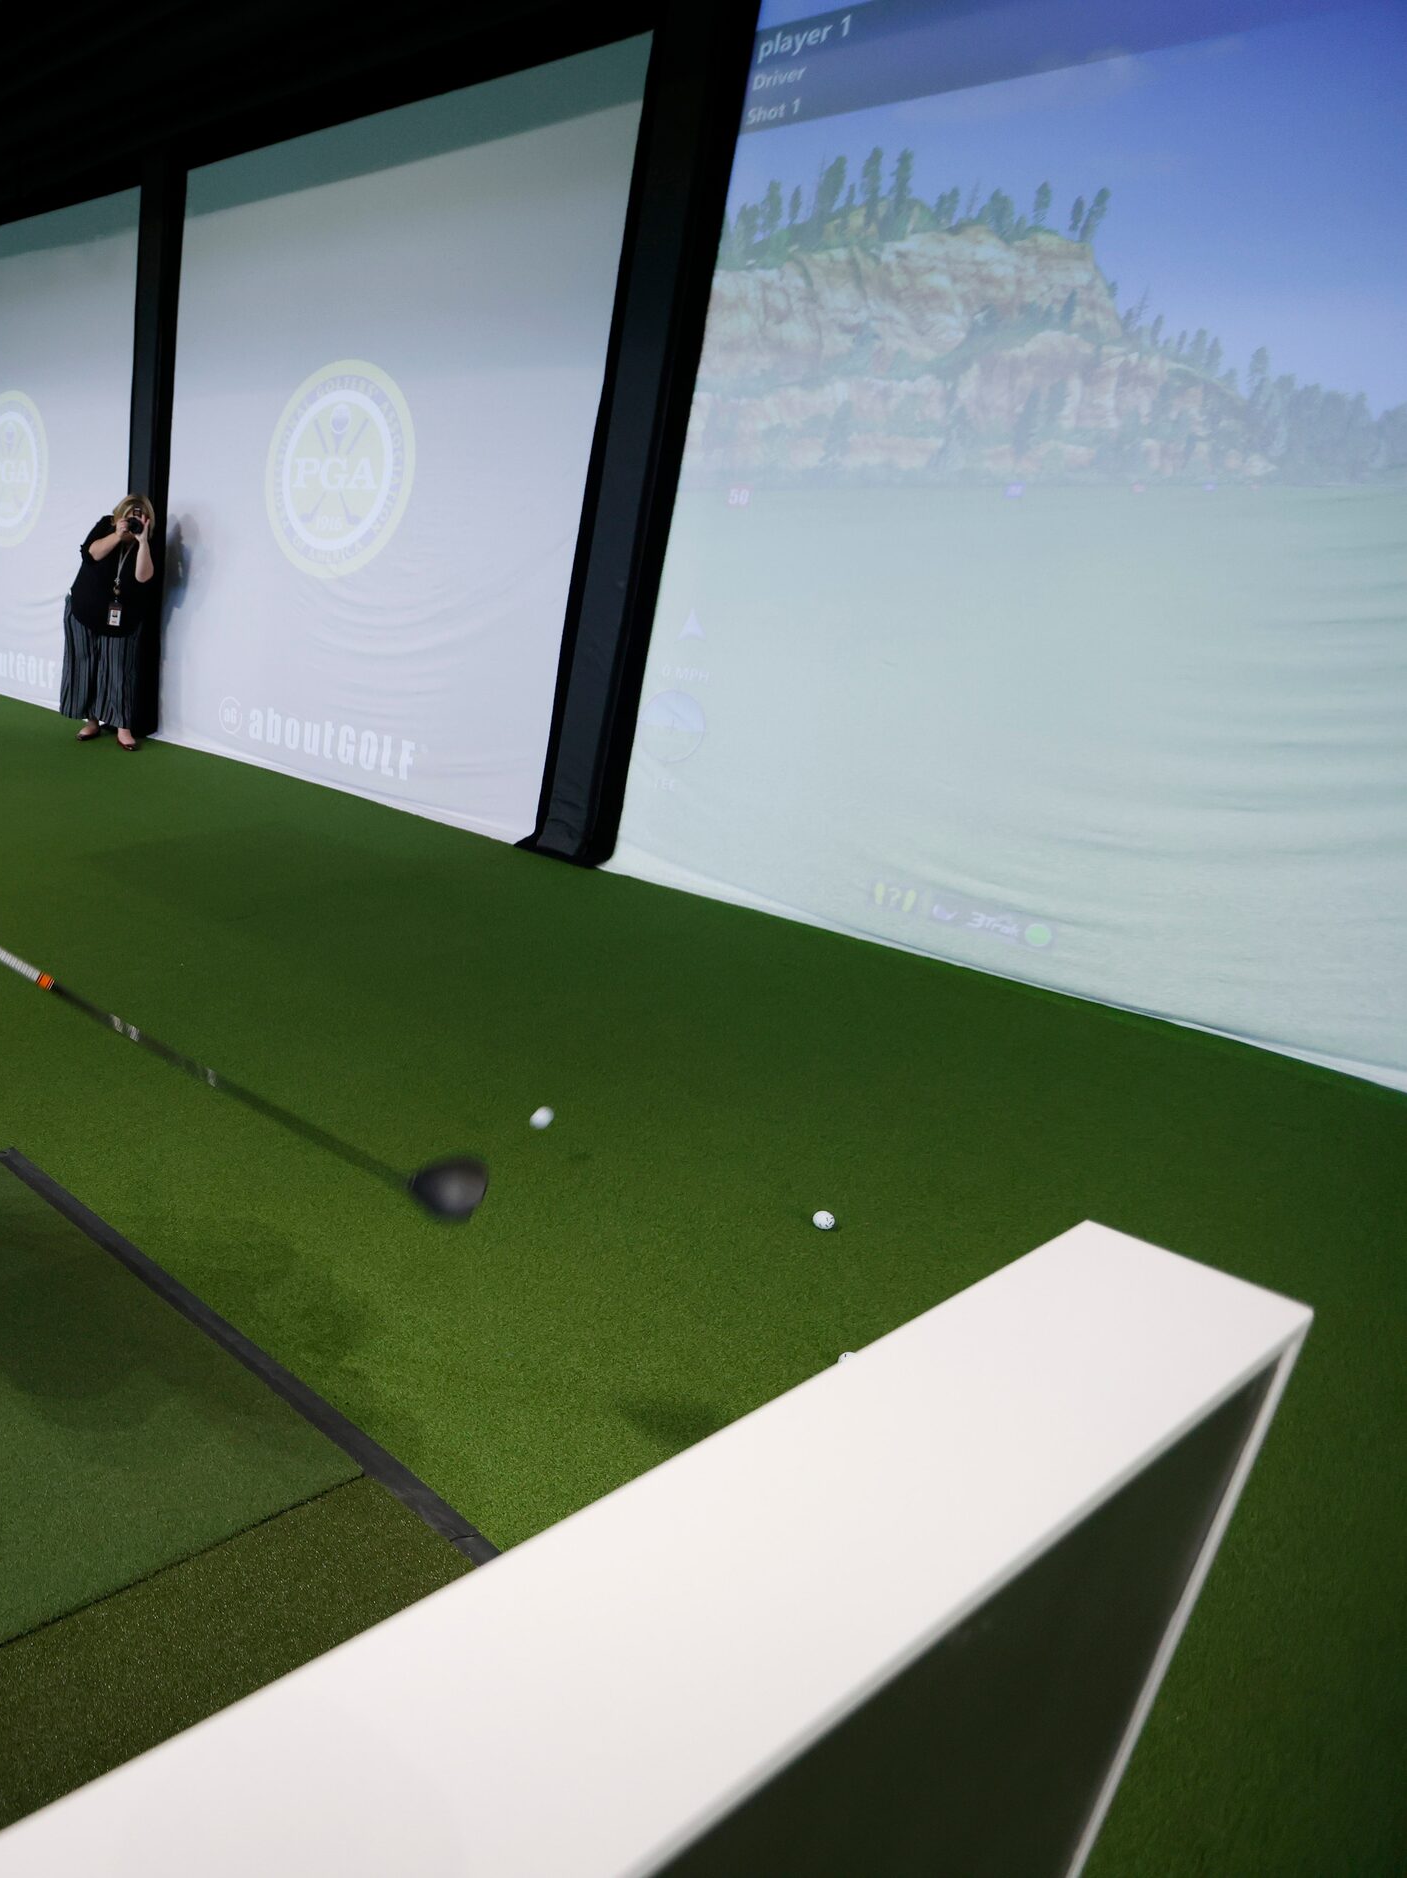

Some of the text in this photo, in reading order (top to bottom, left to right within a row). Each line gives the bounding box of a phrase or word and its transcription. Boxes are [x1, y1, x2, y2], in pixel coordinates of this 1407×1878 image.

[756, 13, 853, 64] player 1
[751, 65, 807, 91] Driver
[745, 98, 802, 126] Shot 1
[291, 456, 378, 491] PGA
[248, 707, 416, 781] aboutGOLF
